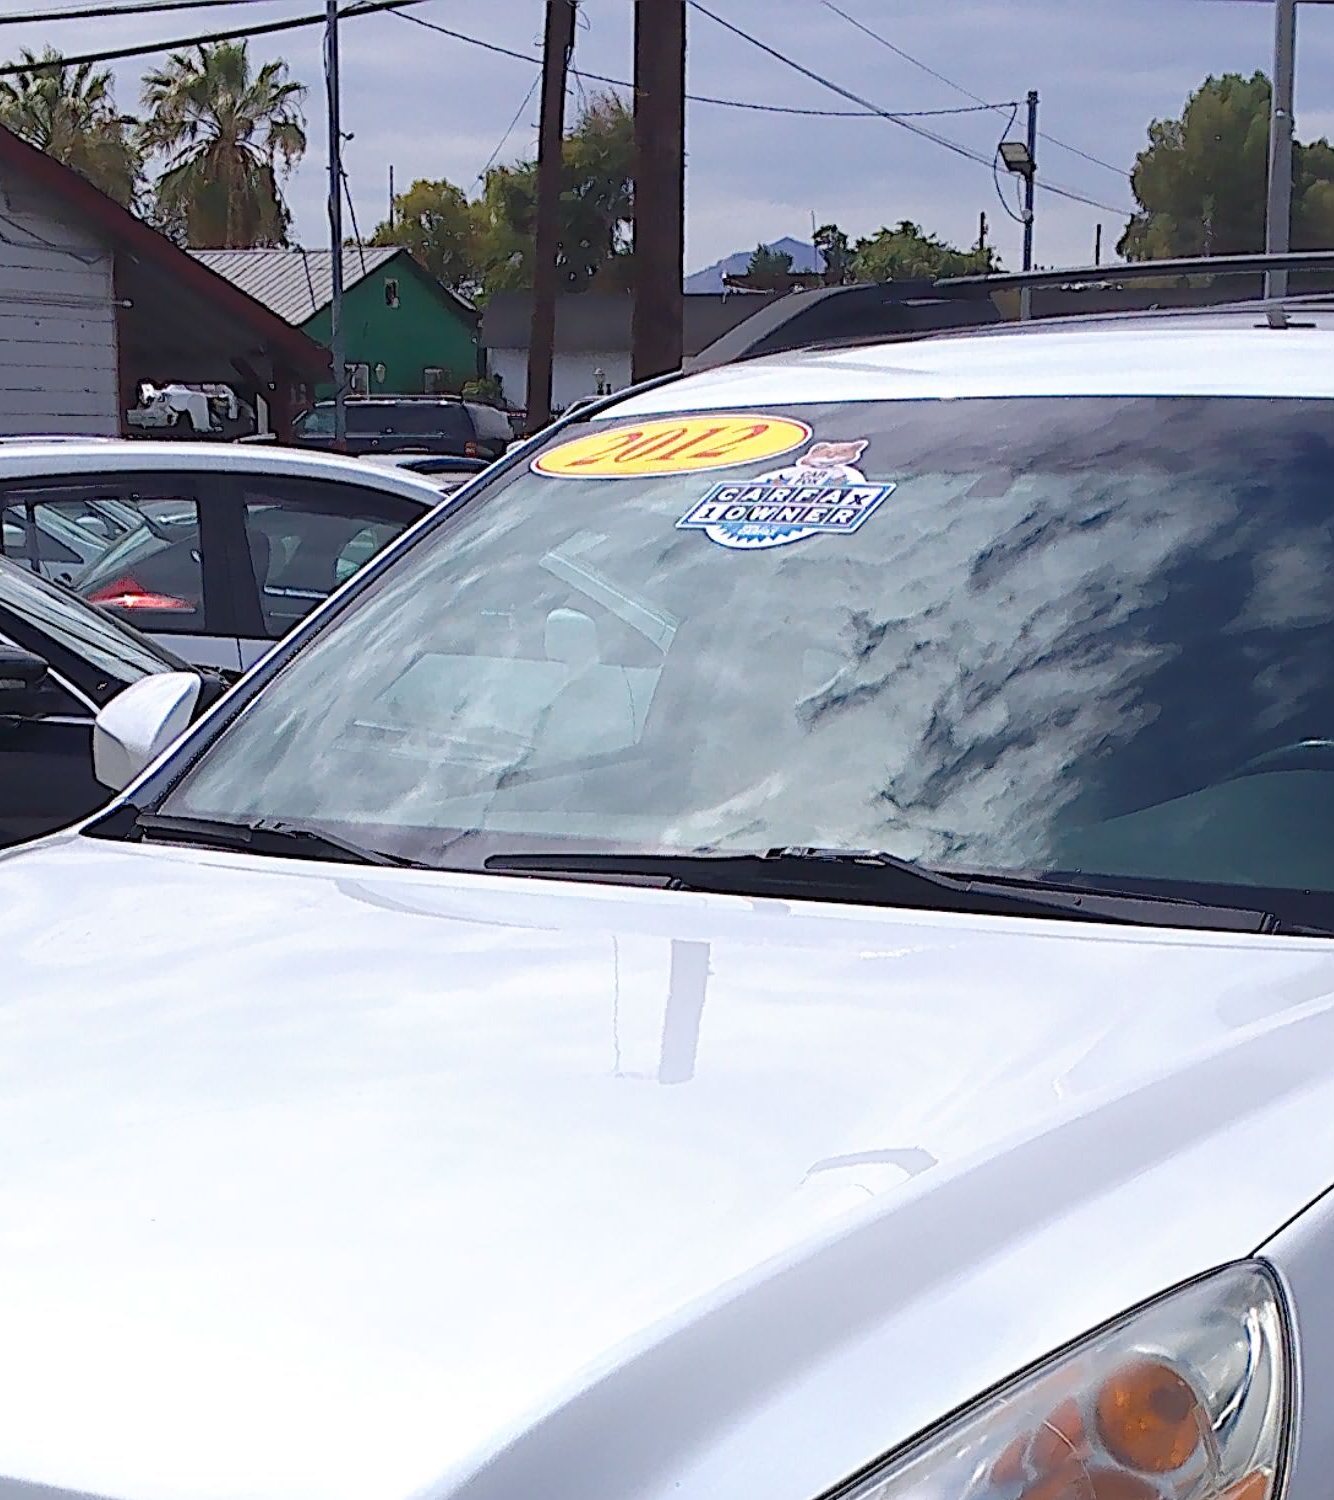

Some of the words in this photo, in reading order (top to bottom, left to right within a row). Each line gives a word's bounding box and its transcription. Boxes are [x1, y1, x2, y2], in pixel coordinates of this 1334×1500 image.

[564, 424, 770, 468] 2012
[715, 487, 869, 506] CARFAX
[725, 505, 857, 524] OWNER
